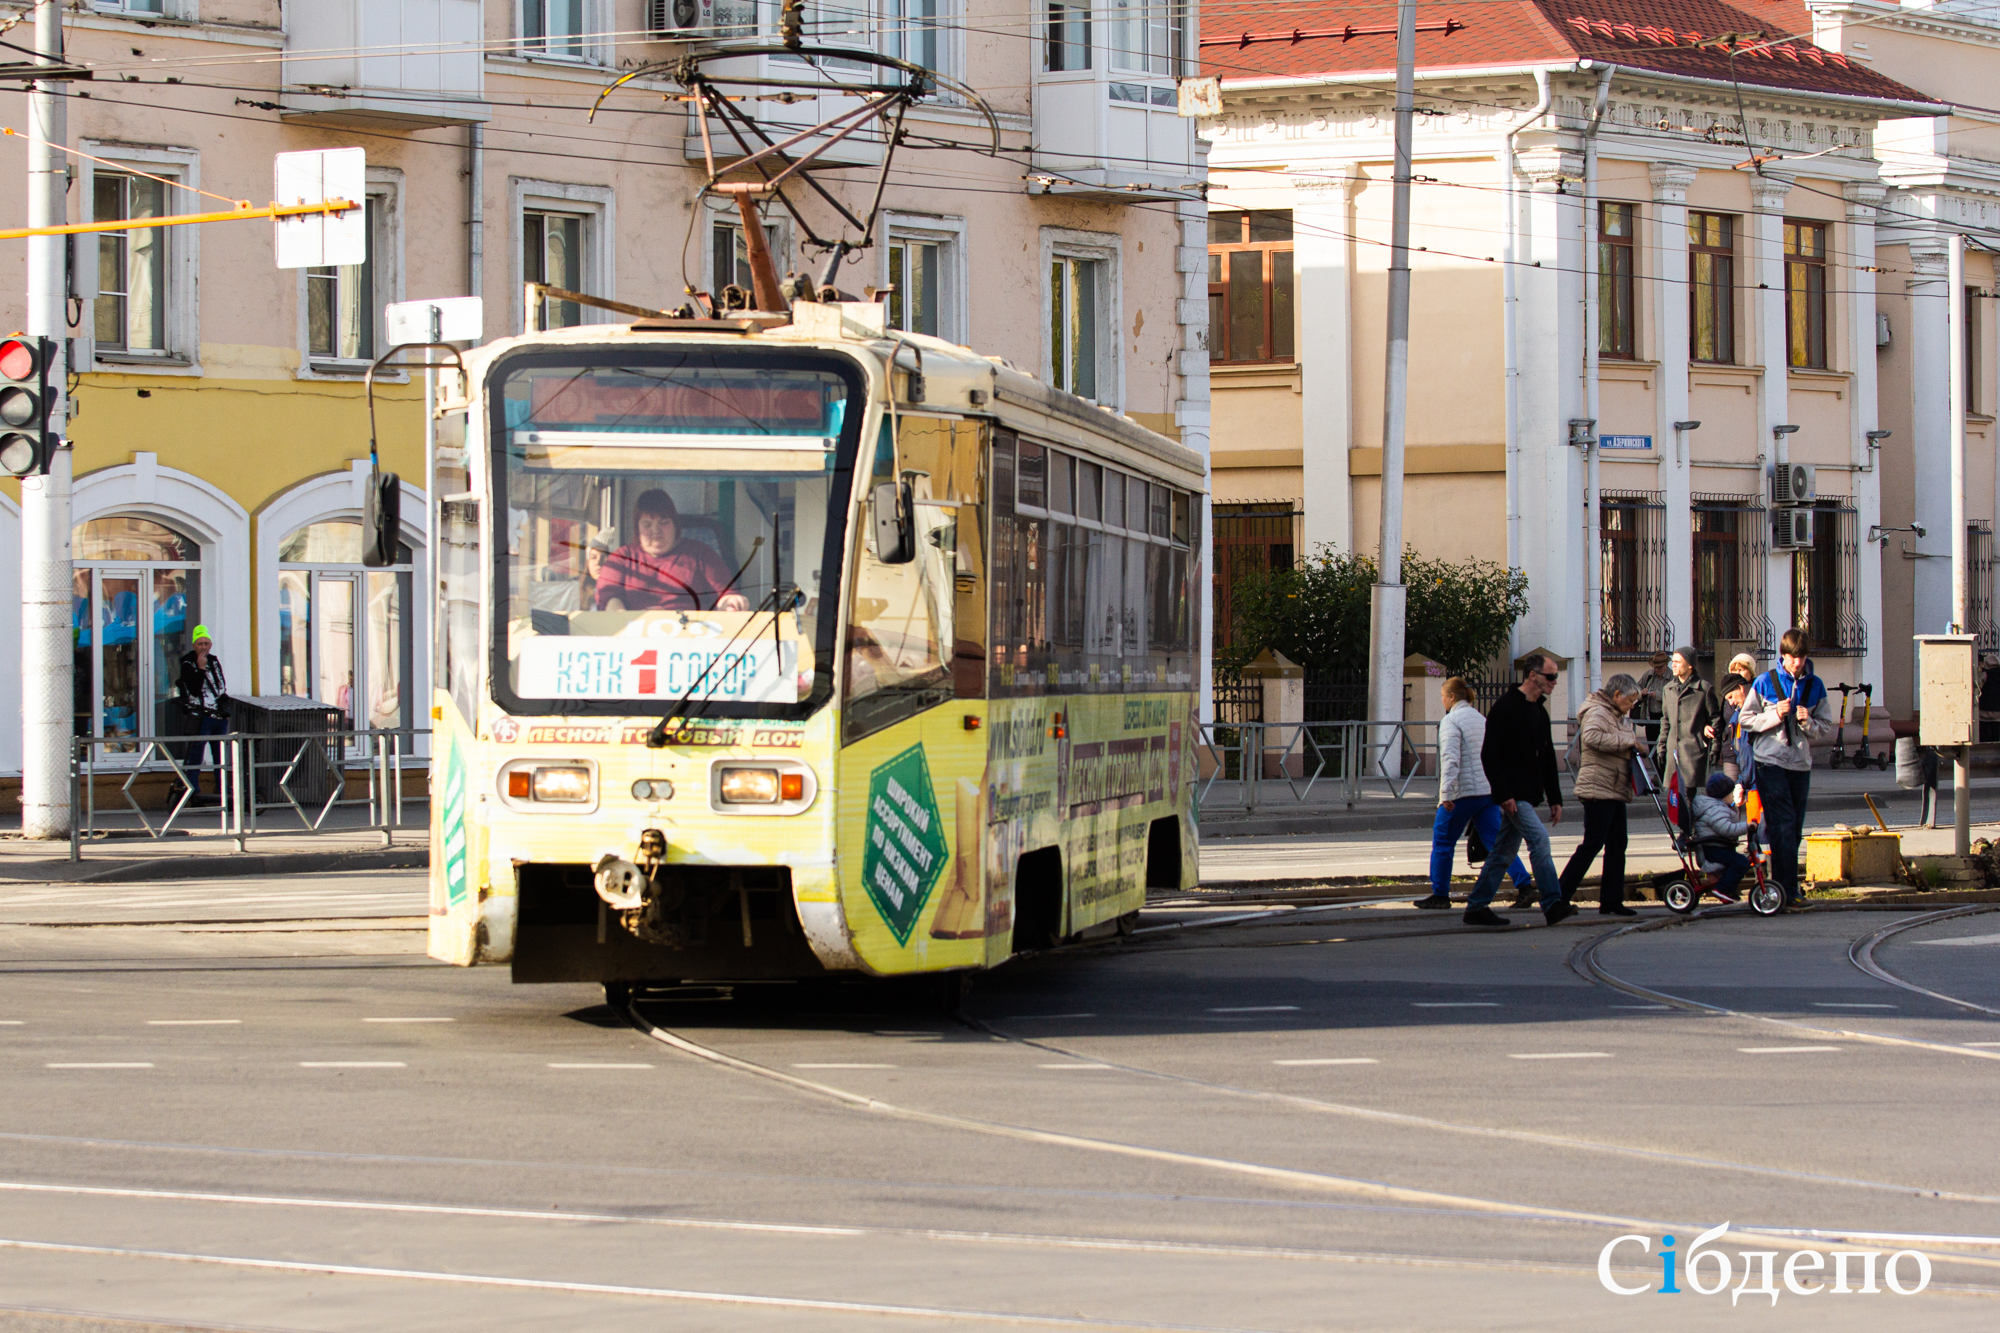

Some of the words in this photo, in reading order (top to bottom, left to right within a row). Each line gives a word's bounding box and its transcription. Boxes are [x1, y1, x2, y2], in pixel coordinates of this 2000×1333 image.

[557, 651, 623, 694] КЭТК
[630, 649, 658, 694] 1
[669, 651, 757, 696] СОБОР
[752, 731, 804, 746] ДОМ
[886, 776, 931, 834] ШИРОКИЙ
[872, 824, 885, 850] ПО
[883, 838, 920, 895] НИЗКИМ
[873, 794, 934, 873] АССОРТИМЕНТ
[874, 861, 905, 912] ЦЕНАМ
